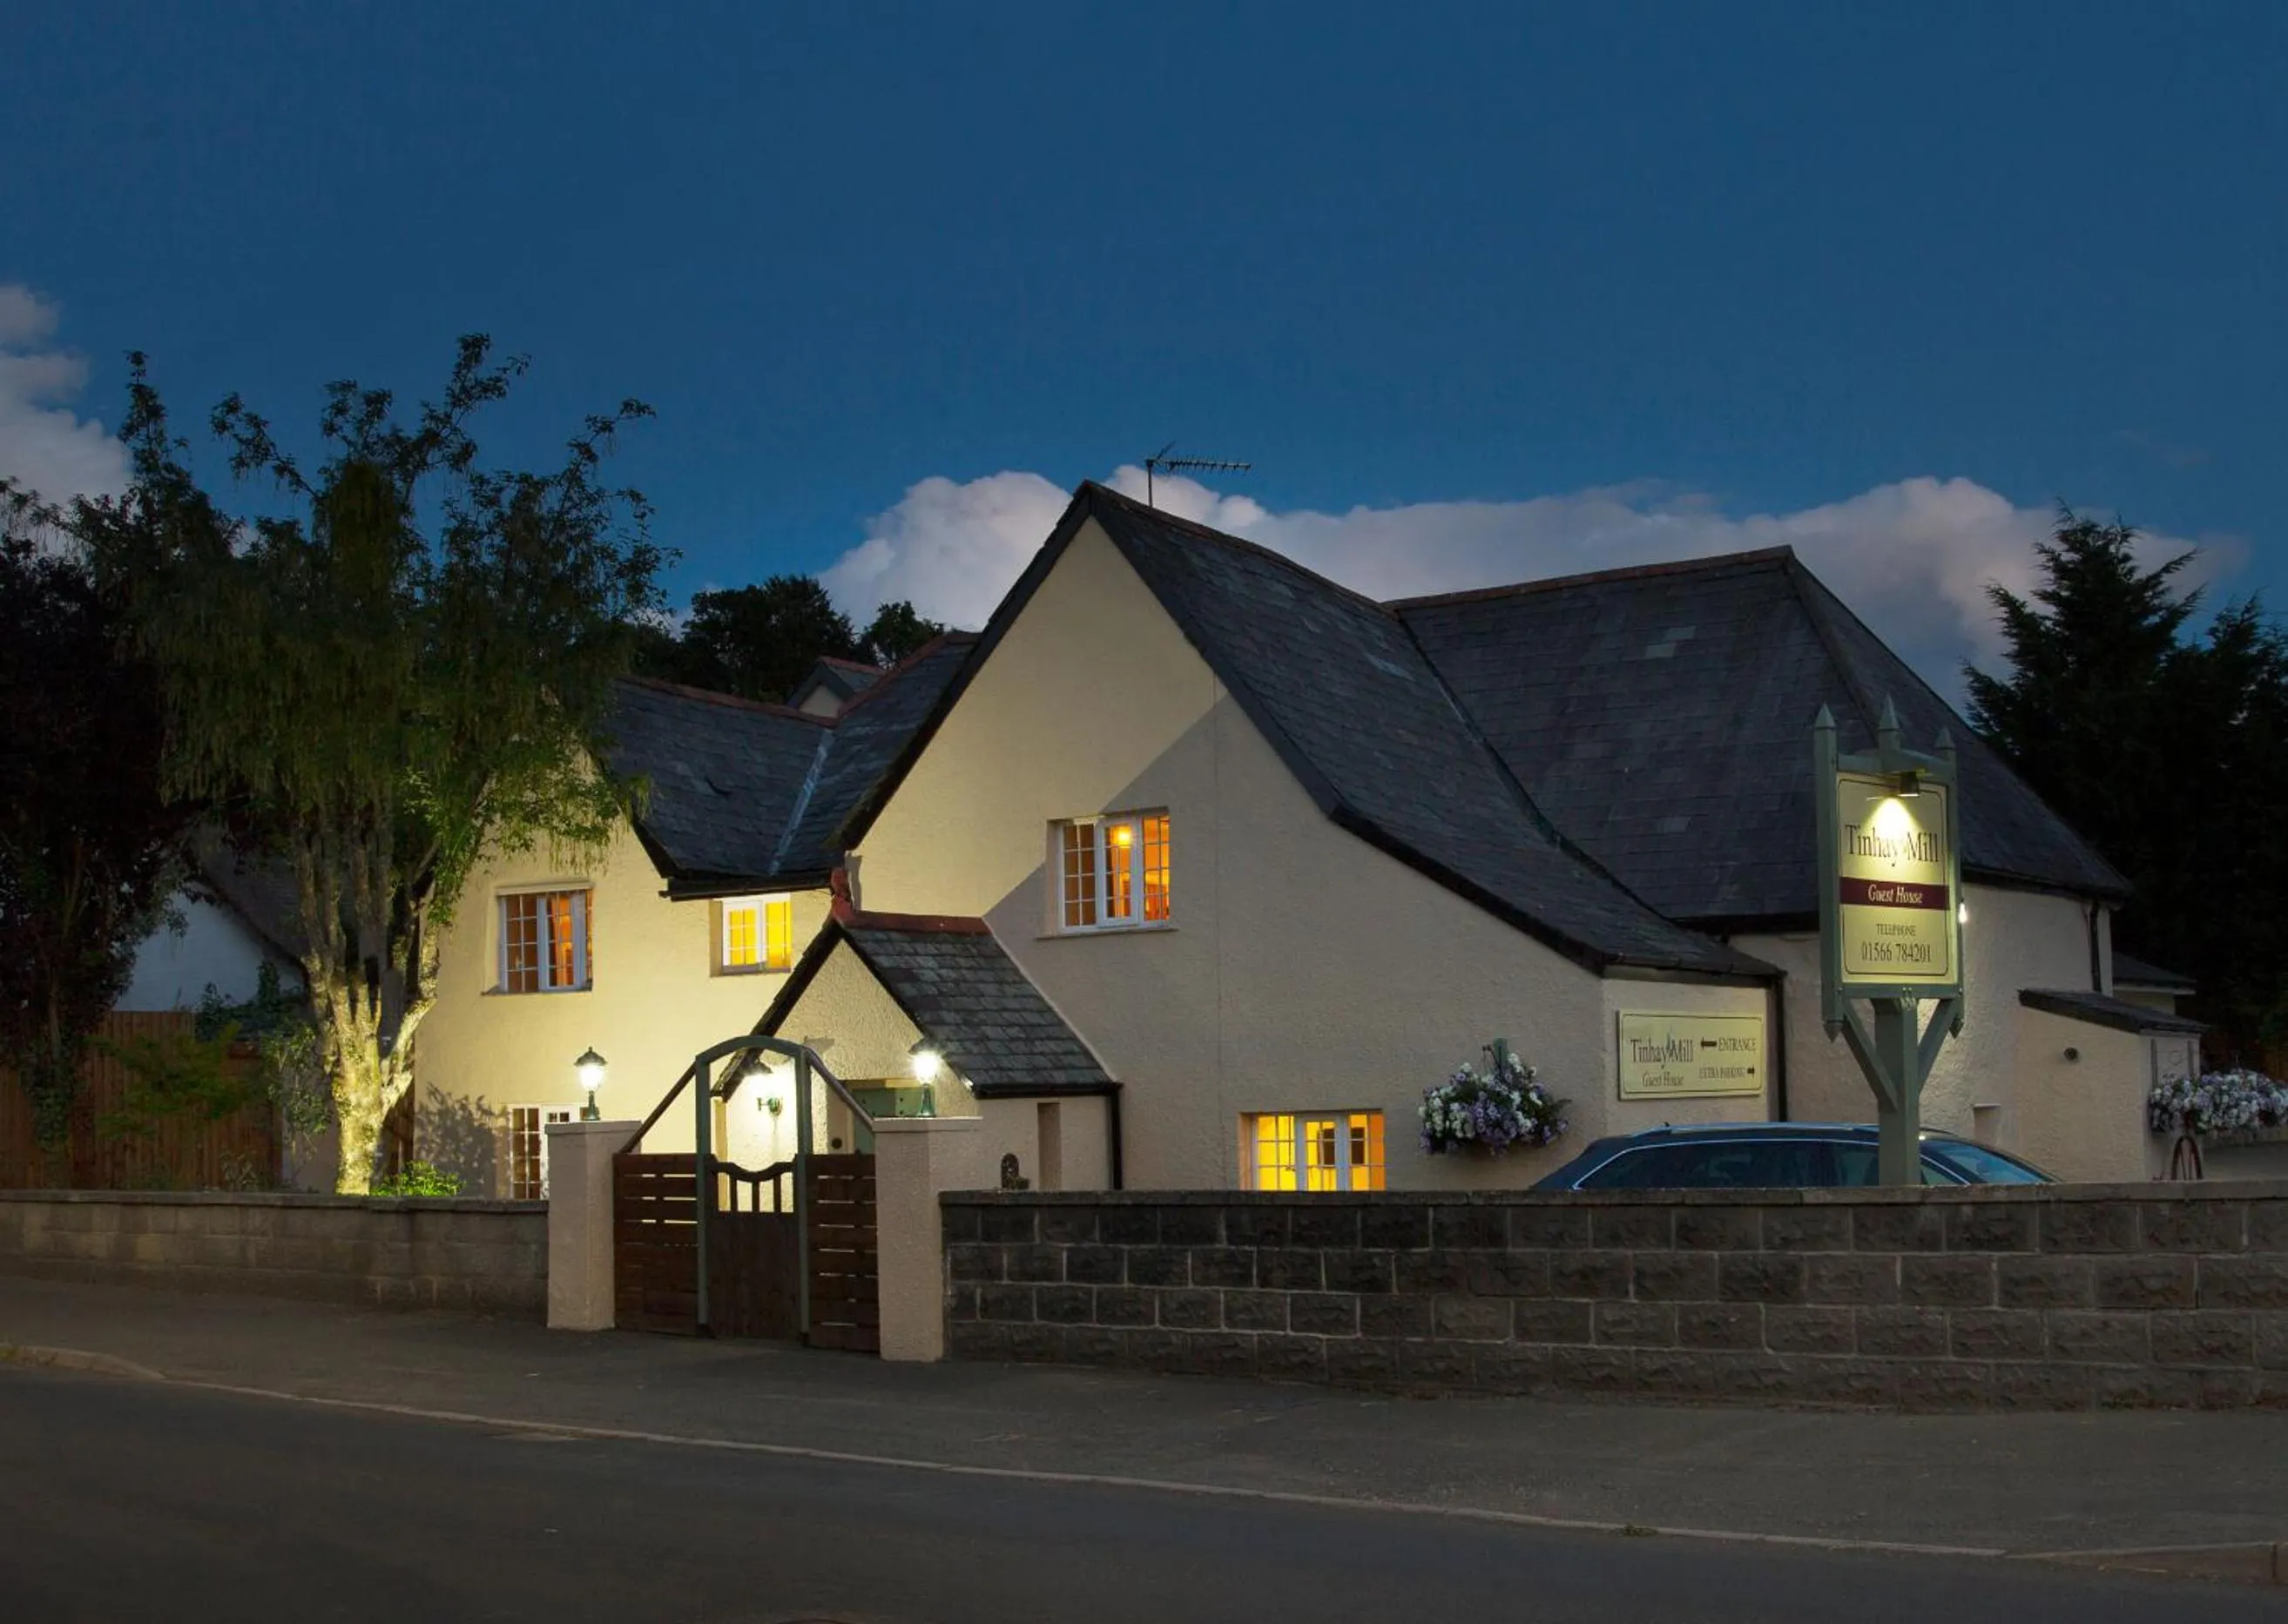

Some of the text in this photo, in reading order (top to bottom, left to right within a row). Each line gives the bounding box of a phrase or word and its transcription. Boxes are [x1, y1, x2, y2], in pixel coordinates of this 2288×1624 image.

[1905, 830, 1940, 863] Mill
[1868, 884, 1923, 904] Guest House
[1875, 923, 1917, 937] TELEPHONE
[1861, 941, 1932, 963] 01566 784201
[1630, 1037, 1694, 1070] Tinhay Mill
[1718, 1037, 1757, 1052] ENTRANCE
[1664, 1072, 1684, 1088] House
